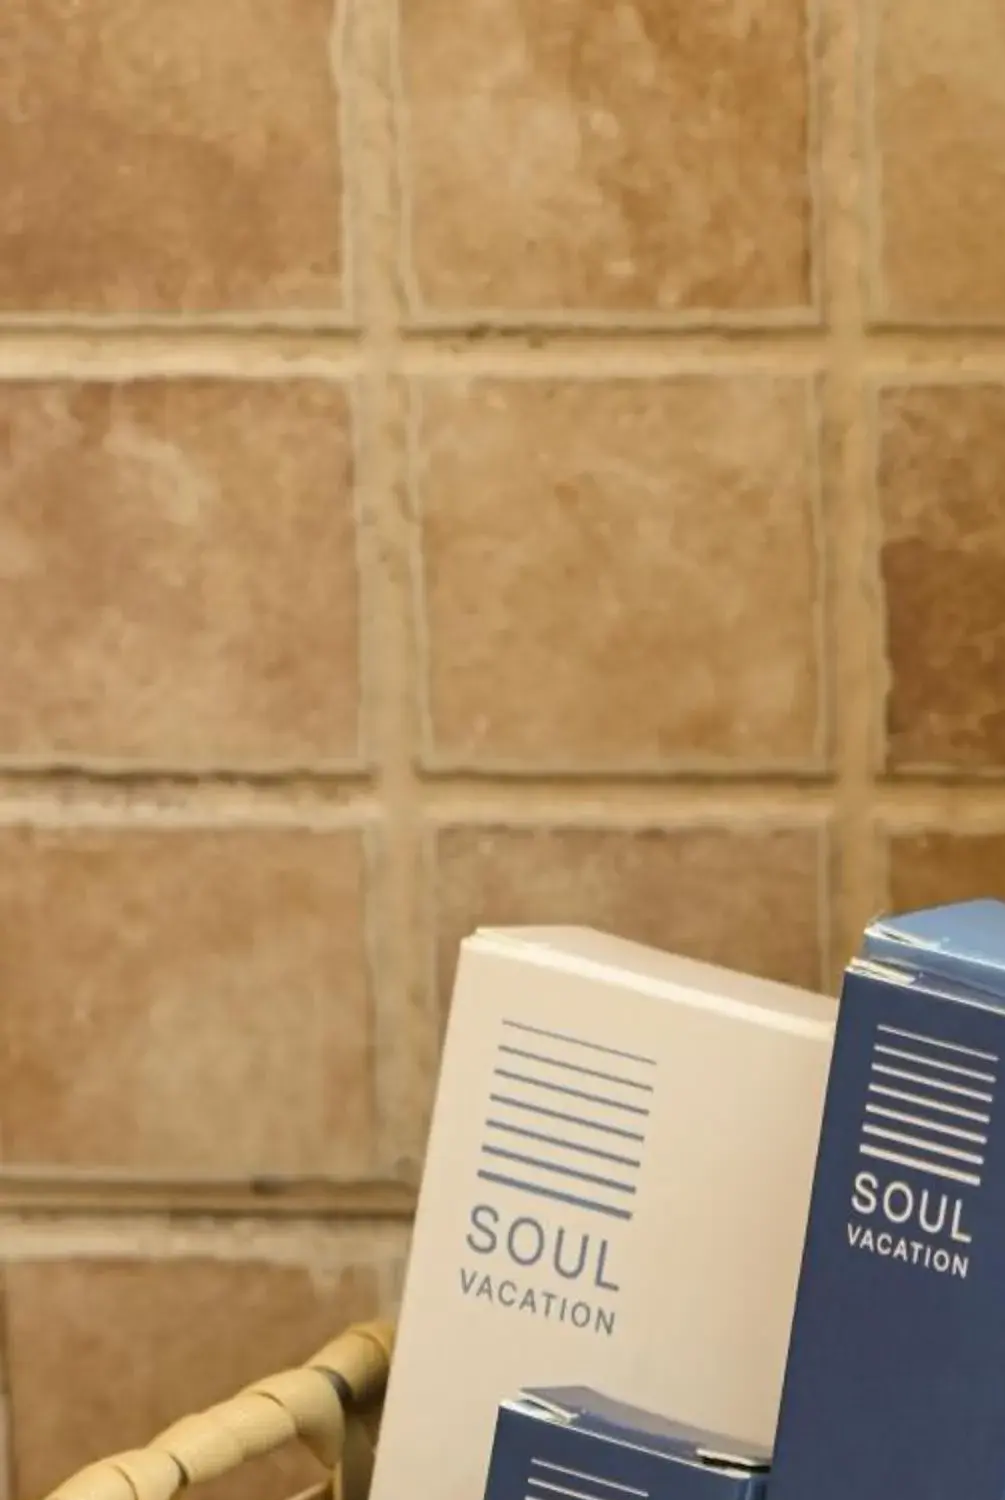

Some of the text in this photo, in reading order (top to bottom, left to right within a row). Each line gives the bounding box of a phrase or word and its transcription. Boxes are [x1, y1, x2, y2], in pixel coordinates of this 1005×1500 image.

[850, 1170, 972, 1244] SOUL
[464, 1203, 620, 1293] SOUL
[846, 1222, 969, 1279] VACATION
[459, 1267, 616, 1336] VACATION
